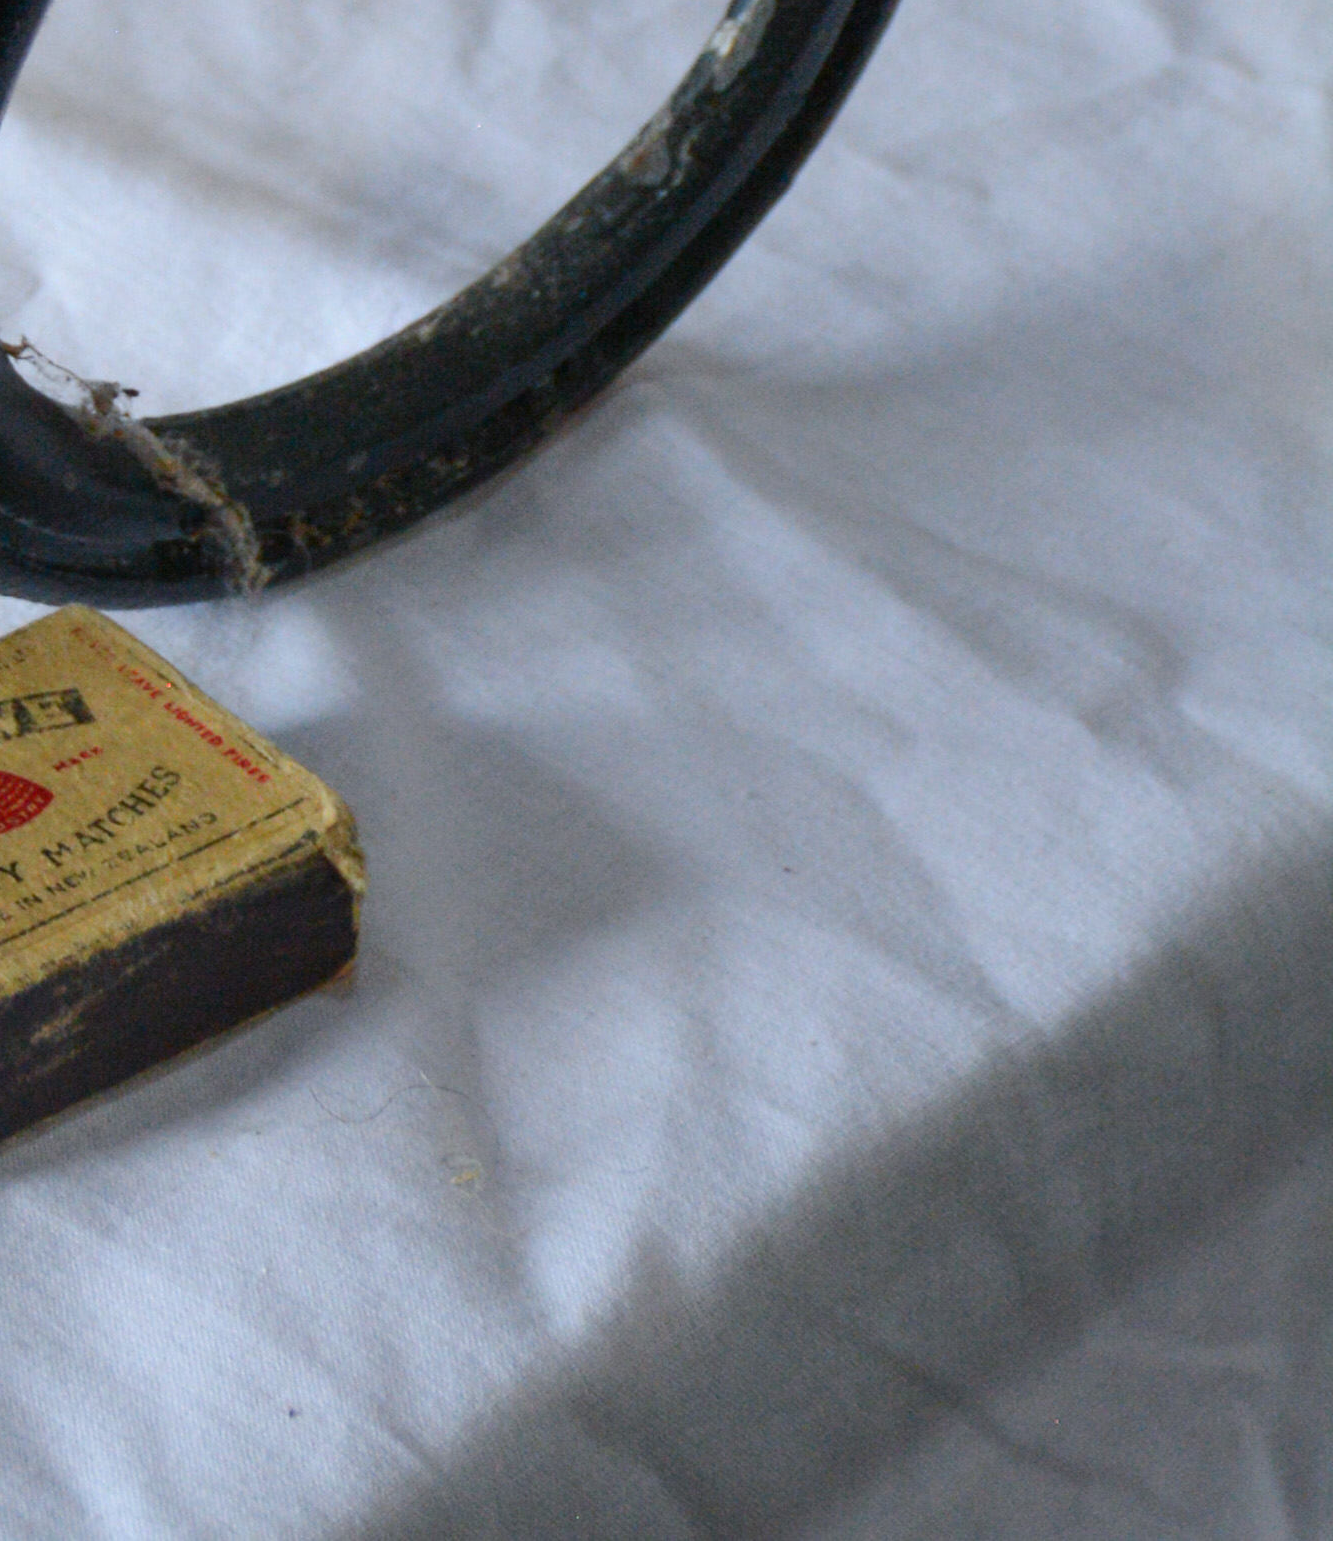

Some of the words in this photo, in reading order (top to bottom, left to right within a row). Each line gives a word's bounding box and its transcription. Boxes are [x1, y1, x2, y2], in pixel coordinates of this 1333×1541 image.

[53, 745, 104, 772] MARK
[16, 891, 43, 911] IN
[45, 868, 98, 897] NEW
[101, 811, 219, 870] ZEALAND
[41, 764, 182, 868] MATCHES
